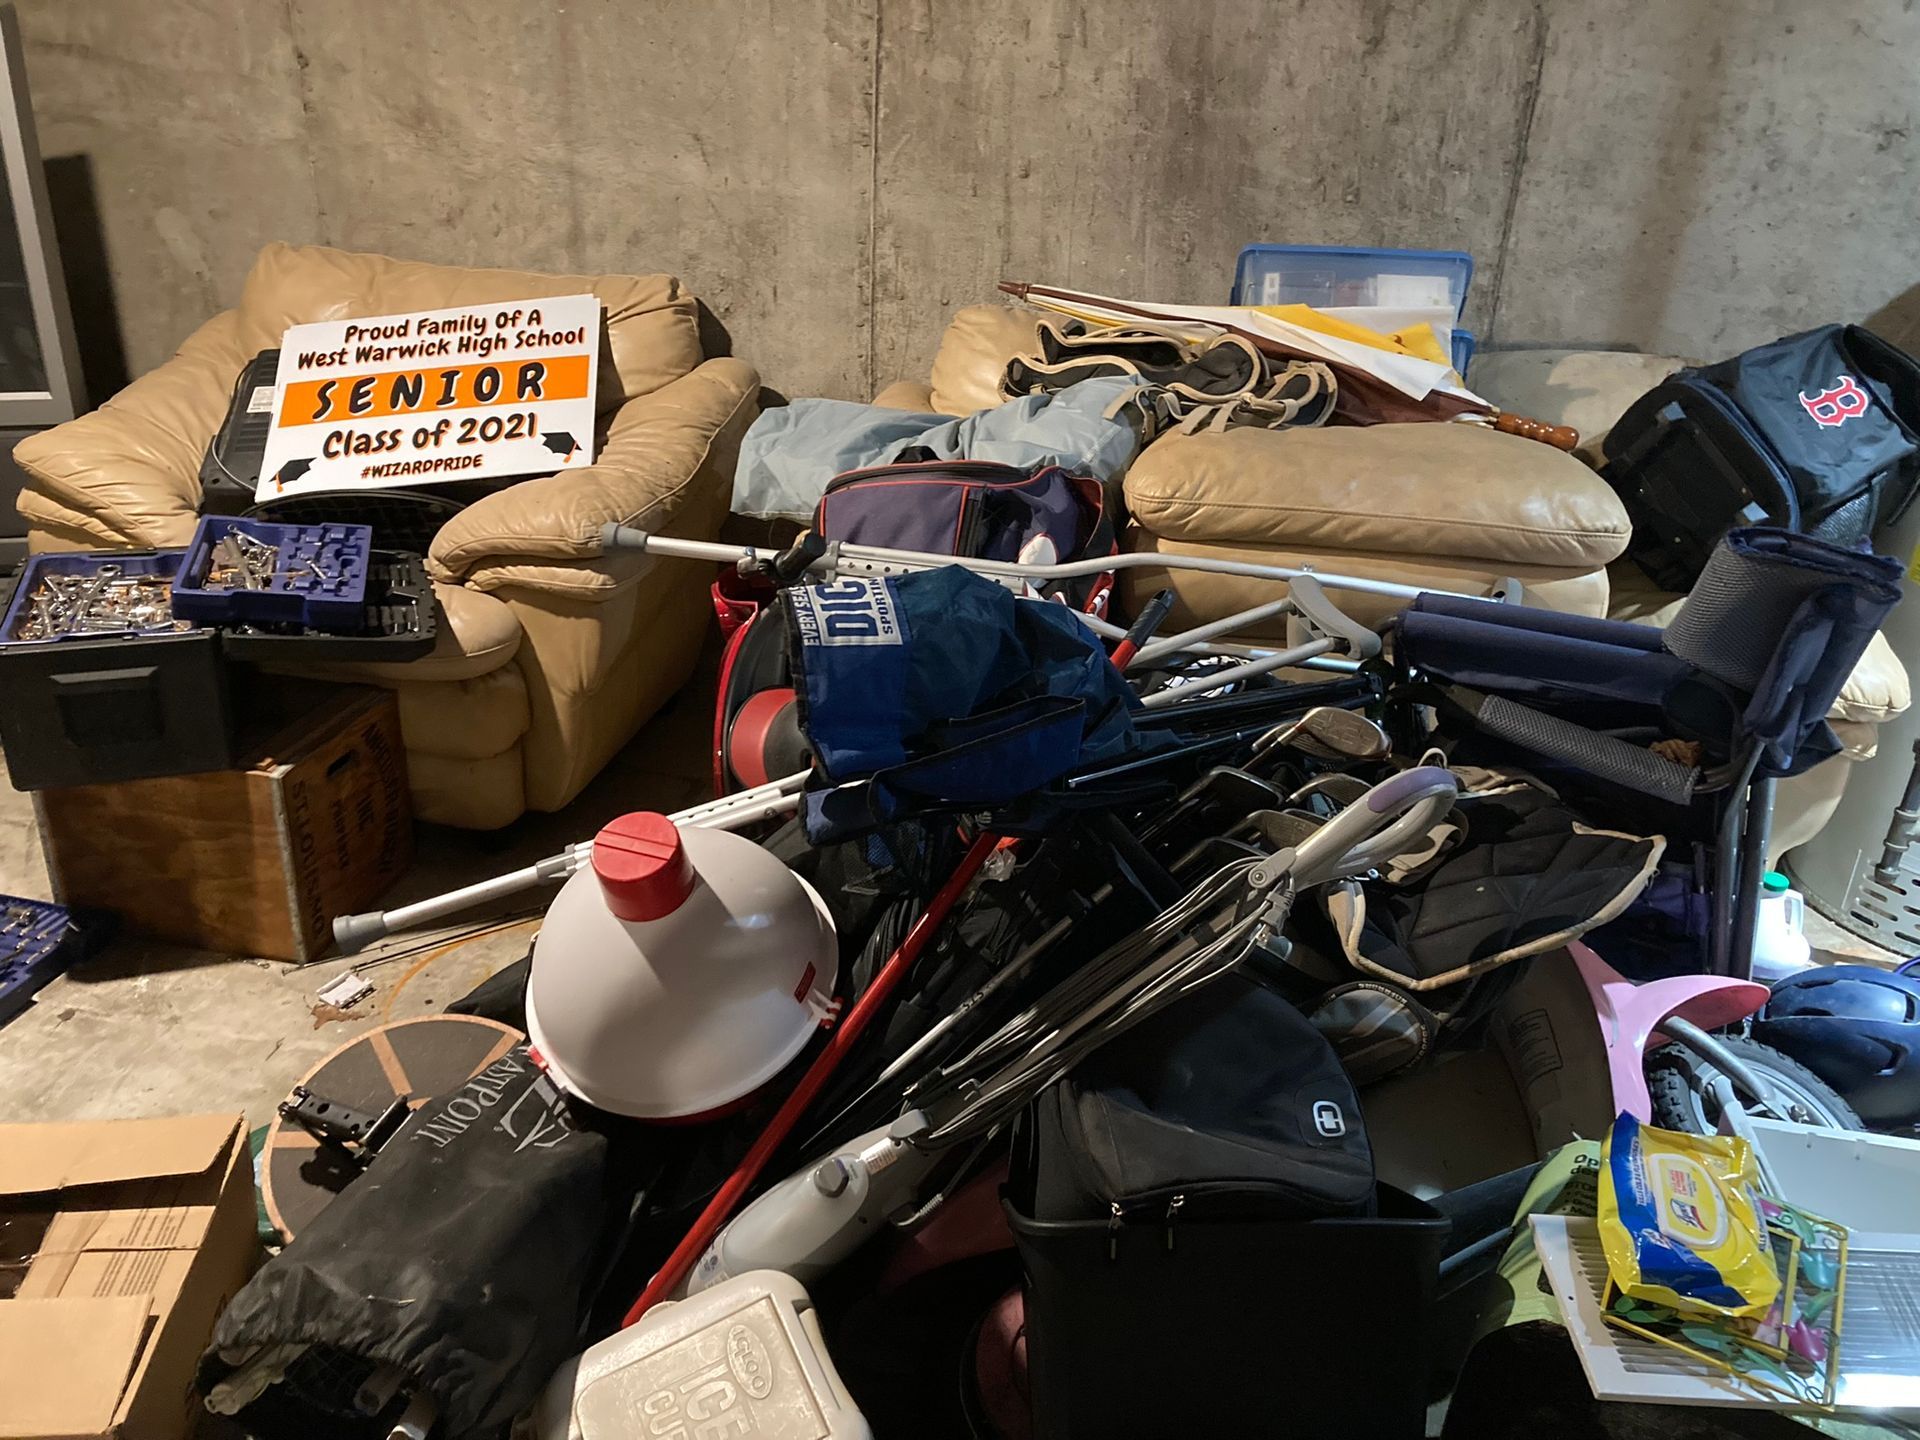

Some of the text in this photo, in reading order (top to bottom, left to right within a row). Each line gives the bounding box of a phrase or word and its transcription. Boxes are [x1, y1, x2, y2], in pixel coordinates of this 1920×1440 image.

[298, 326, 586, 370] West Warwick High School
[344, 309, 542, 344] Proud Family Of A
[312, 361, 547, 420] SENIOR
[322, 412, 537, 459] Class of 2021
[360, 453, 484, 479] #WIZARDPRIDE
[797, 610, 820, 646] EVERY
[732, 1329, 765, 1390] IGLOO
[679, 1363, 750, 1440] ICE
